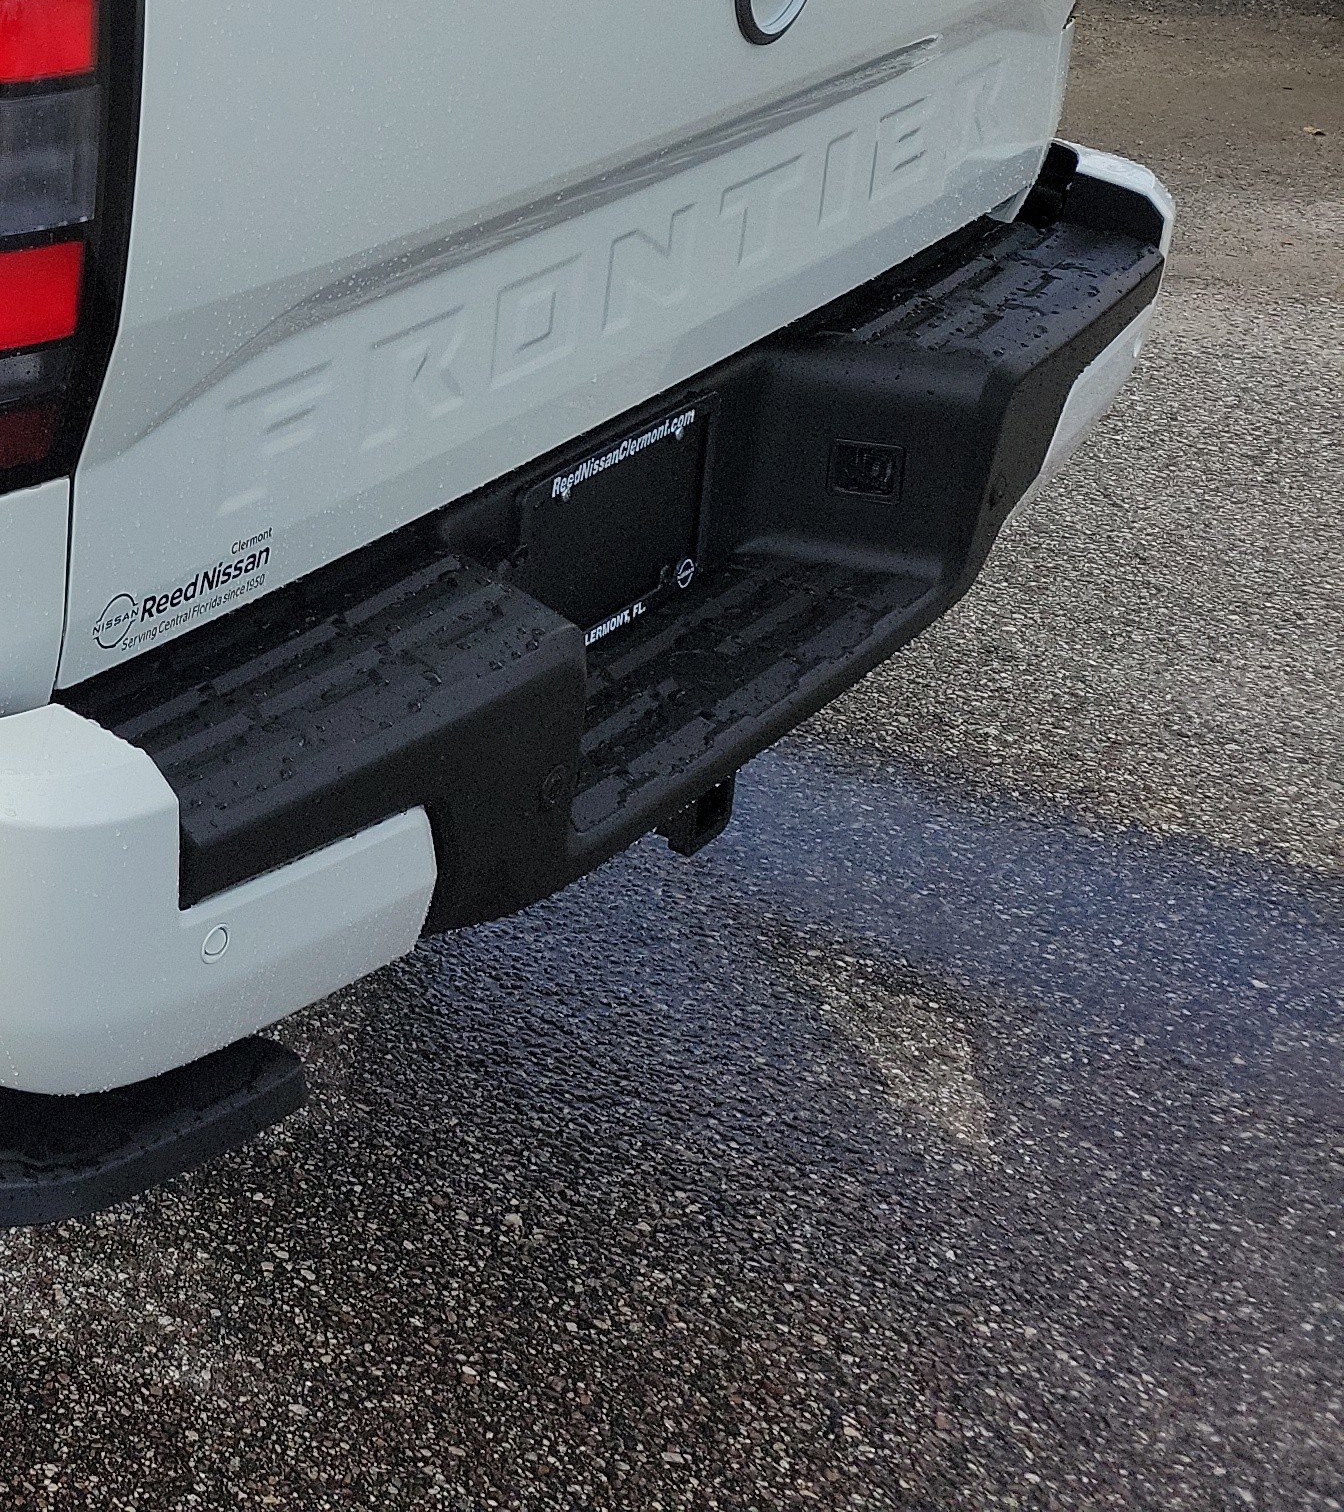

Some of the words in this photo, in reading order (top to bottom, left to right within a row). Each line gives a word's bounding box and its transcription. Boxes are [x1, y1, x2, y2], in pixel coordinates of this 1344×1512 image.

[551, 409, 695, 498] ReedNissanClermont.com
[231, 527, 272, 554] Clermont
[121, 626, 158, 651] Serving
[158, 607, 191, 634] Central
[191, 596, 223, 619] Florida
[223, 585, 246, 603] since
[246, 573, 266, 592] 1950
[140, 574, 199, 622] Reed
[199, 547, 270, 595] Nissan
[92, 607, 139, 636] NISSAN
[585, 609, 631, 646] LERMONT,
